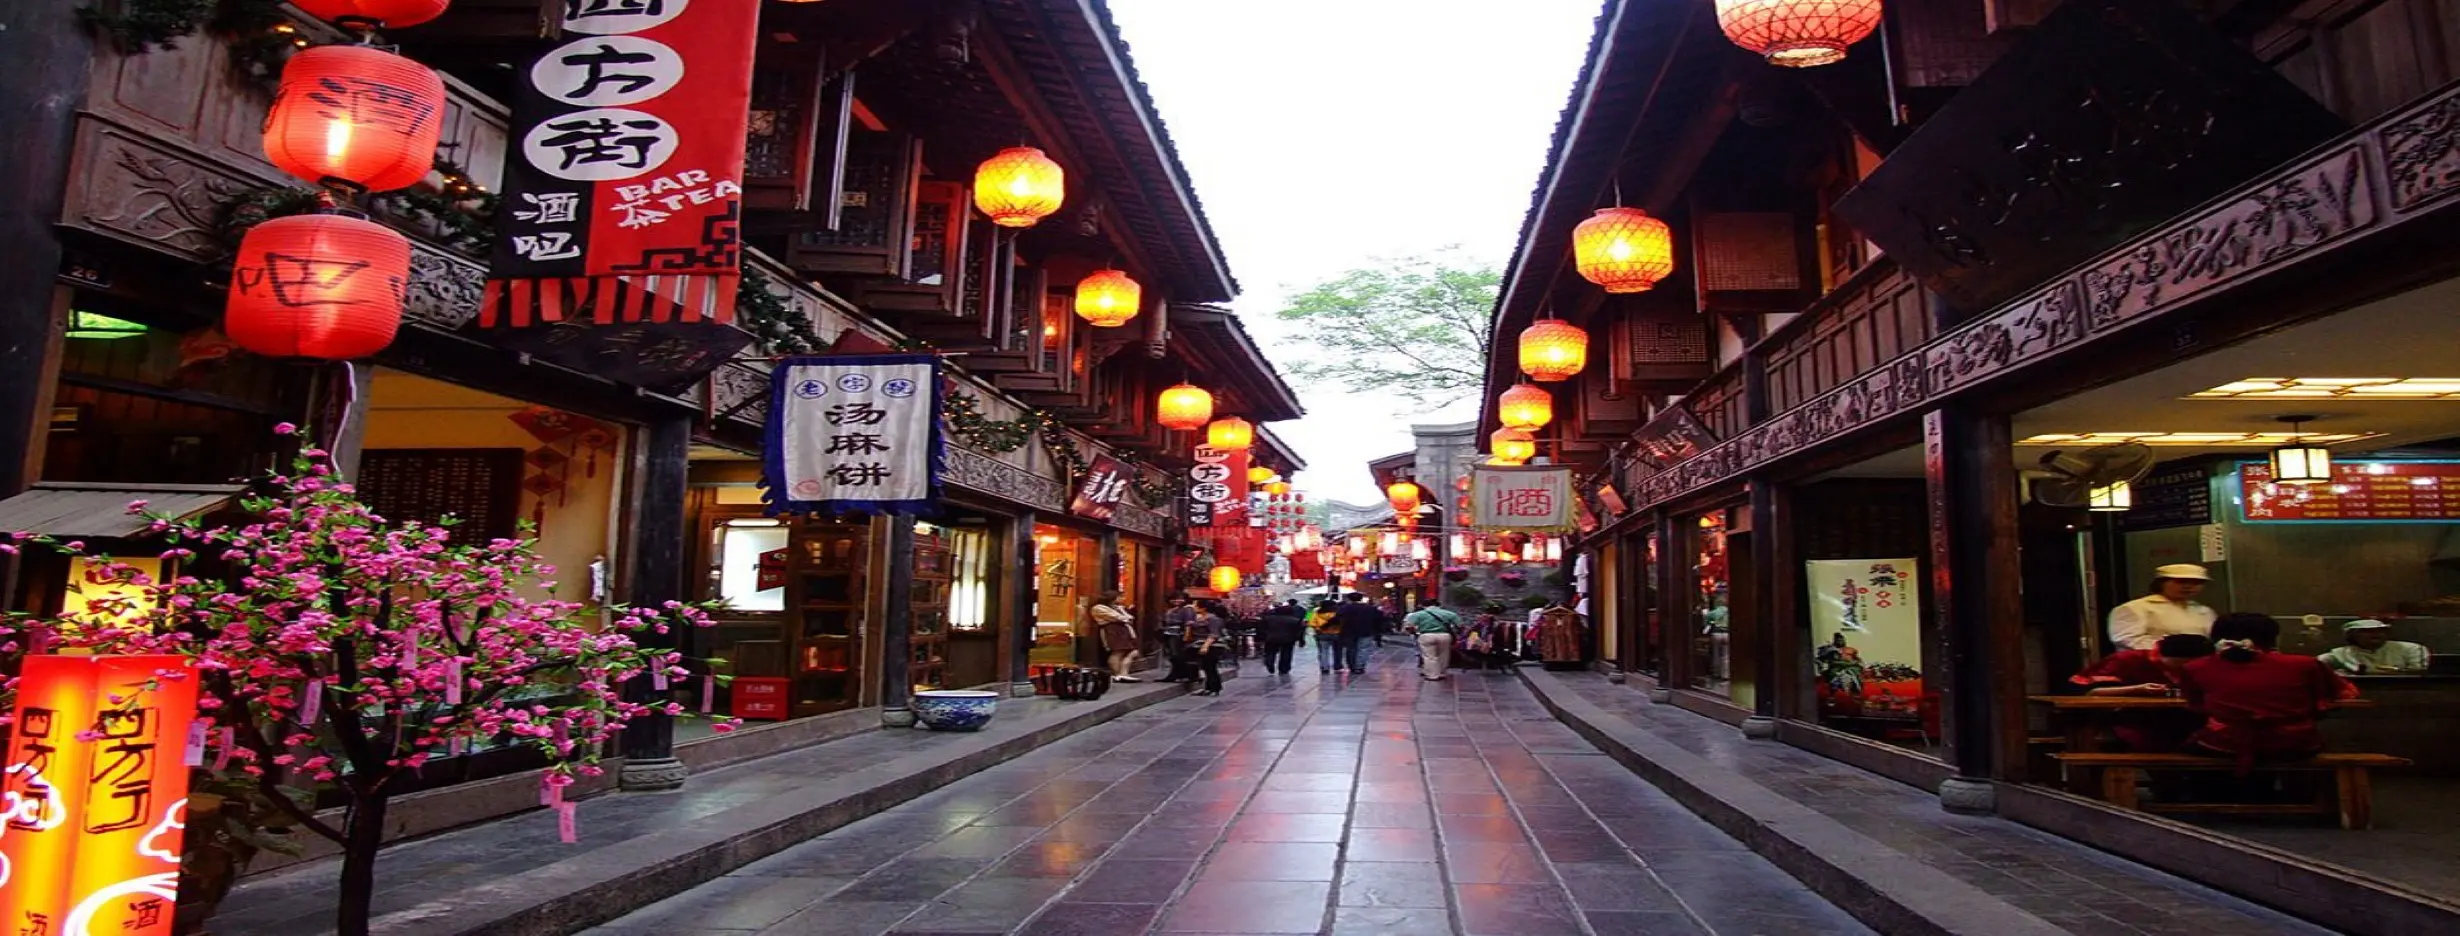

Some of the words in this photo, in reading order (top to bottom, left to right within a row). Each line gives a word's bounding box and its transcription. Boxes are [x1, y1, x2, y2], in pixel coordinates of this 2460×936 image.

[306, 76, 435, 136] 酒
[609, 198, 673, 230] 茶
[657, 179, 742, 212] TEA
[615, 169, 711, 202] BAR
[512, 192, 581, 261] 酒吧
[823, 401, 892, 487] 汤麻饼
[1495, 488, 1553, 517] 酒
[122, 898, 163, 931] 酒
